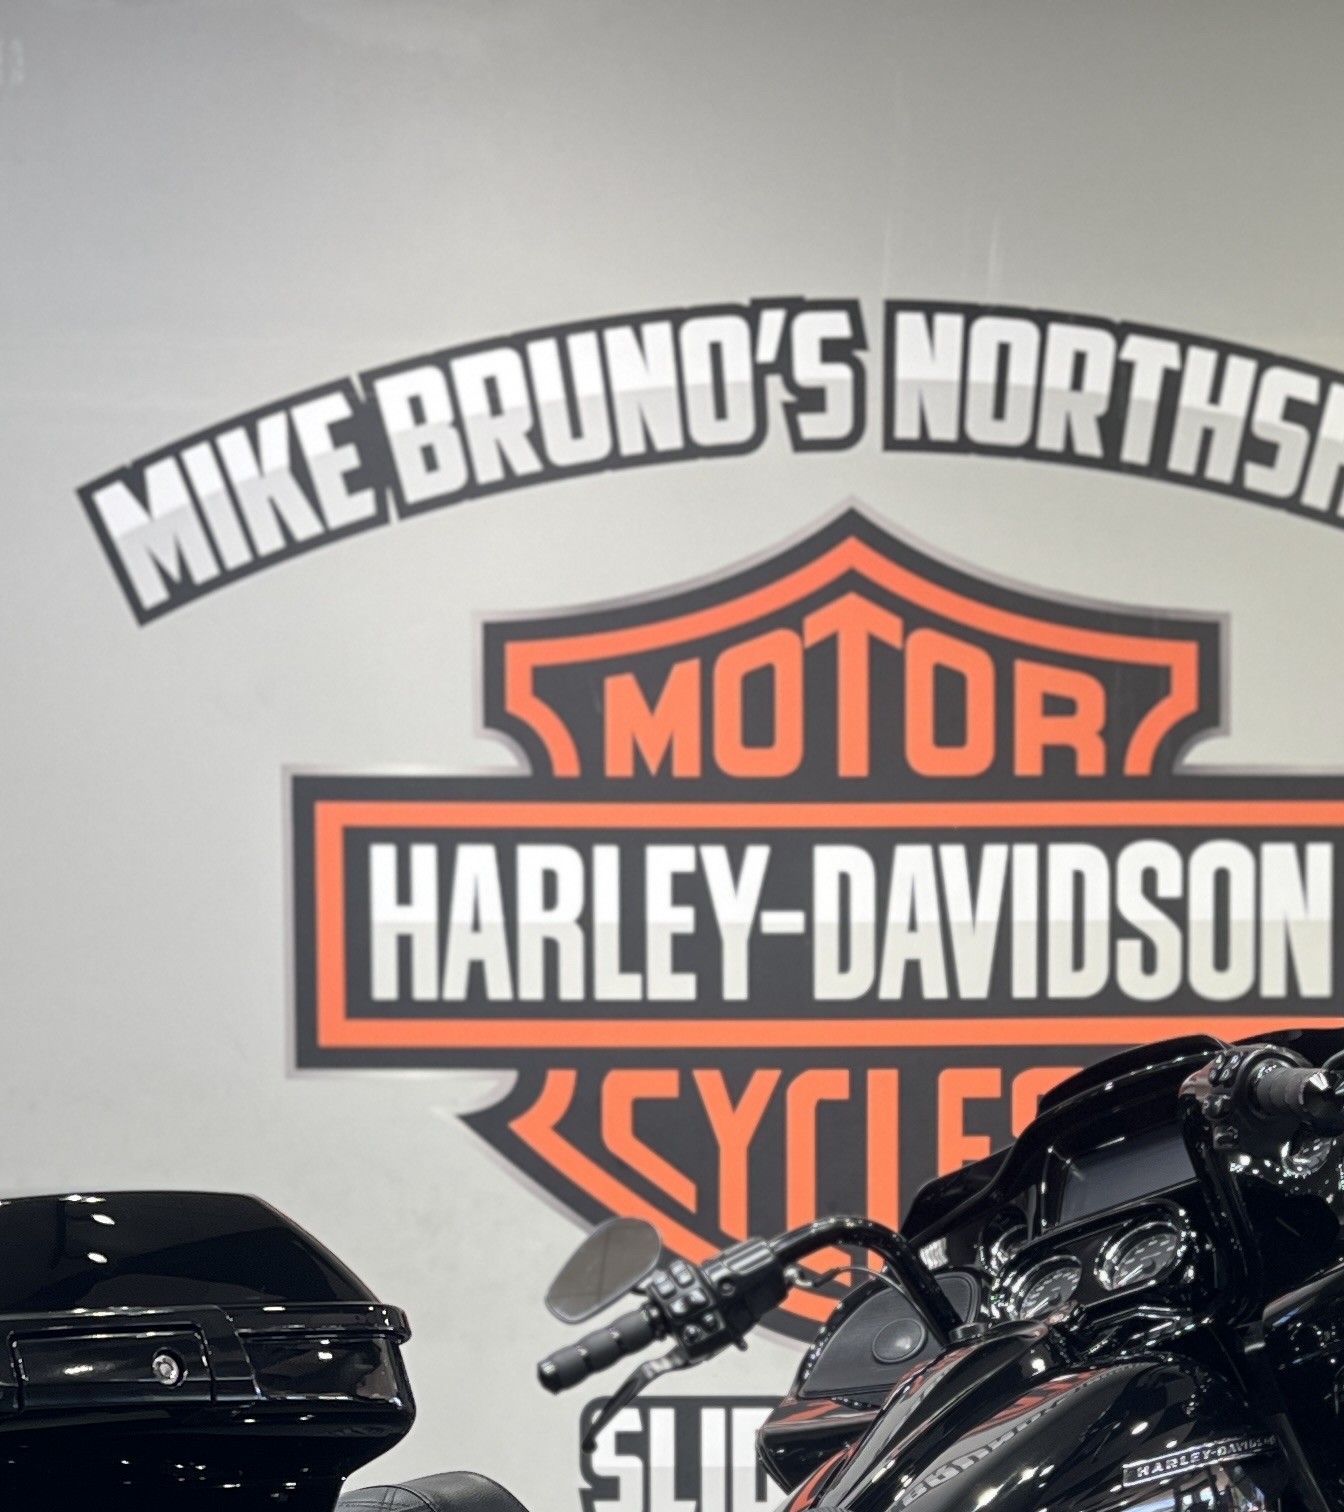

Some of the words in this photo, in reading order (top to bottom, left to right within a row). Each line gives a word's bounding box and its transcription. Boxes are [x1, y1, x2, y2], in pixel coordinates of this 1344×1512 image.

[92, 391, 378, 611] MIKE
[373, 309, 856, 506] BRUNO'S
[602, 590, 1108, 778] MOTOR
[369, 840, 1335, 1003] HARLEY-DAVIDSON
